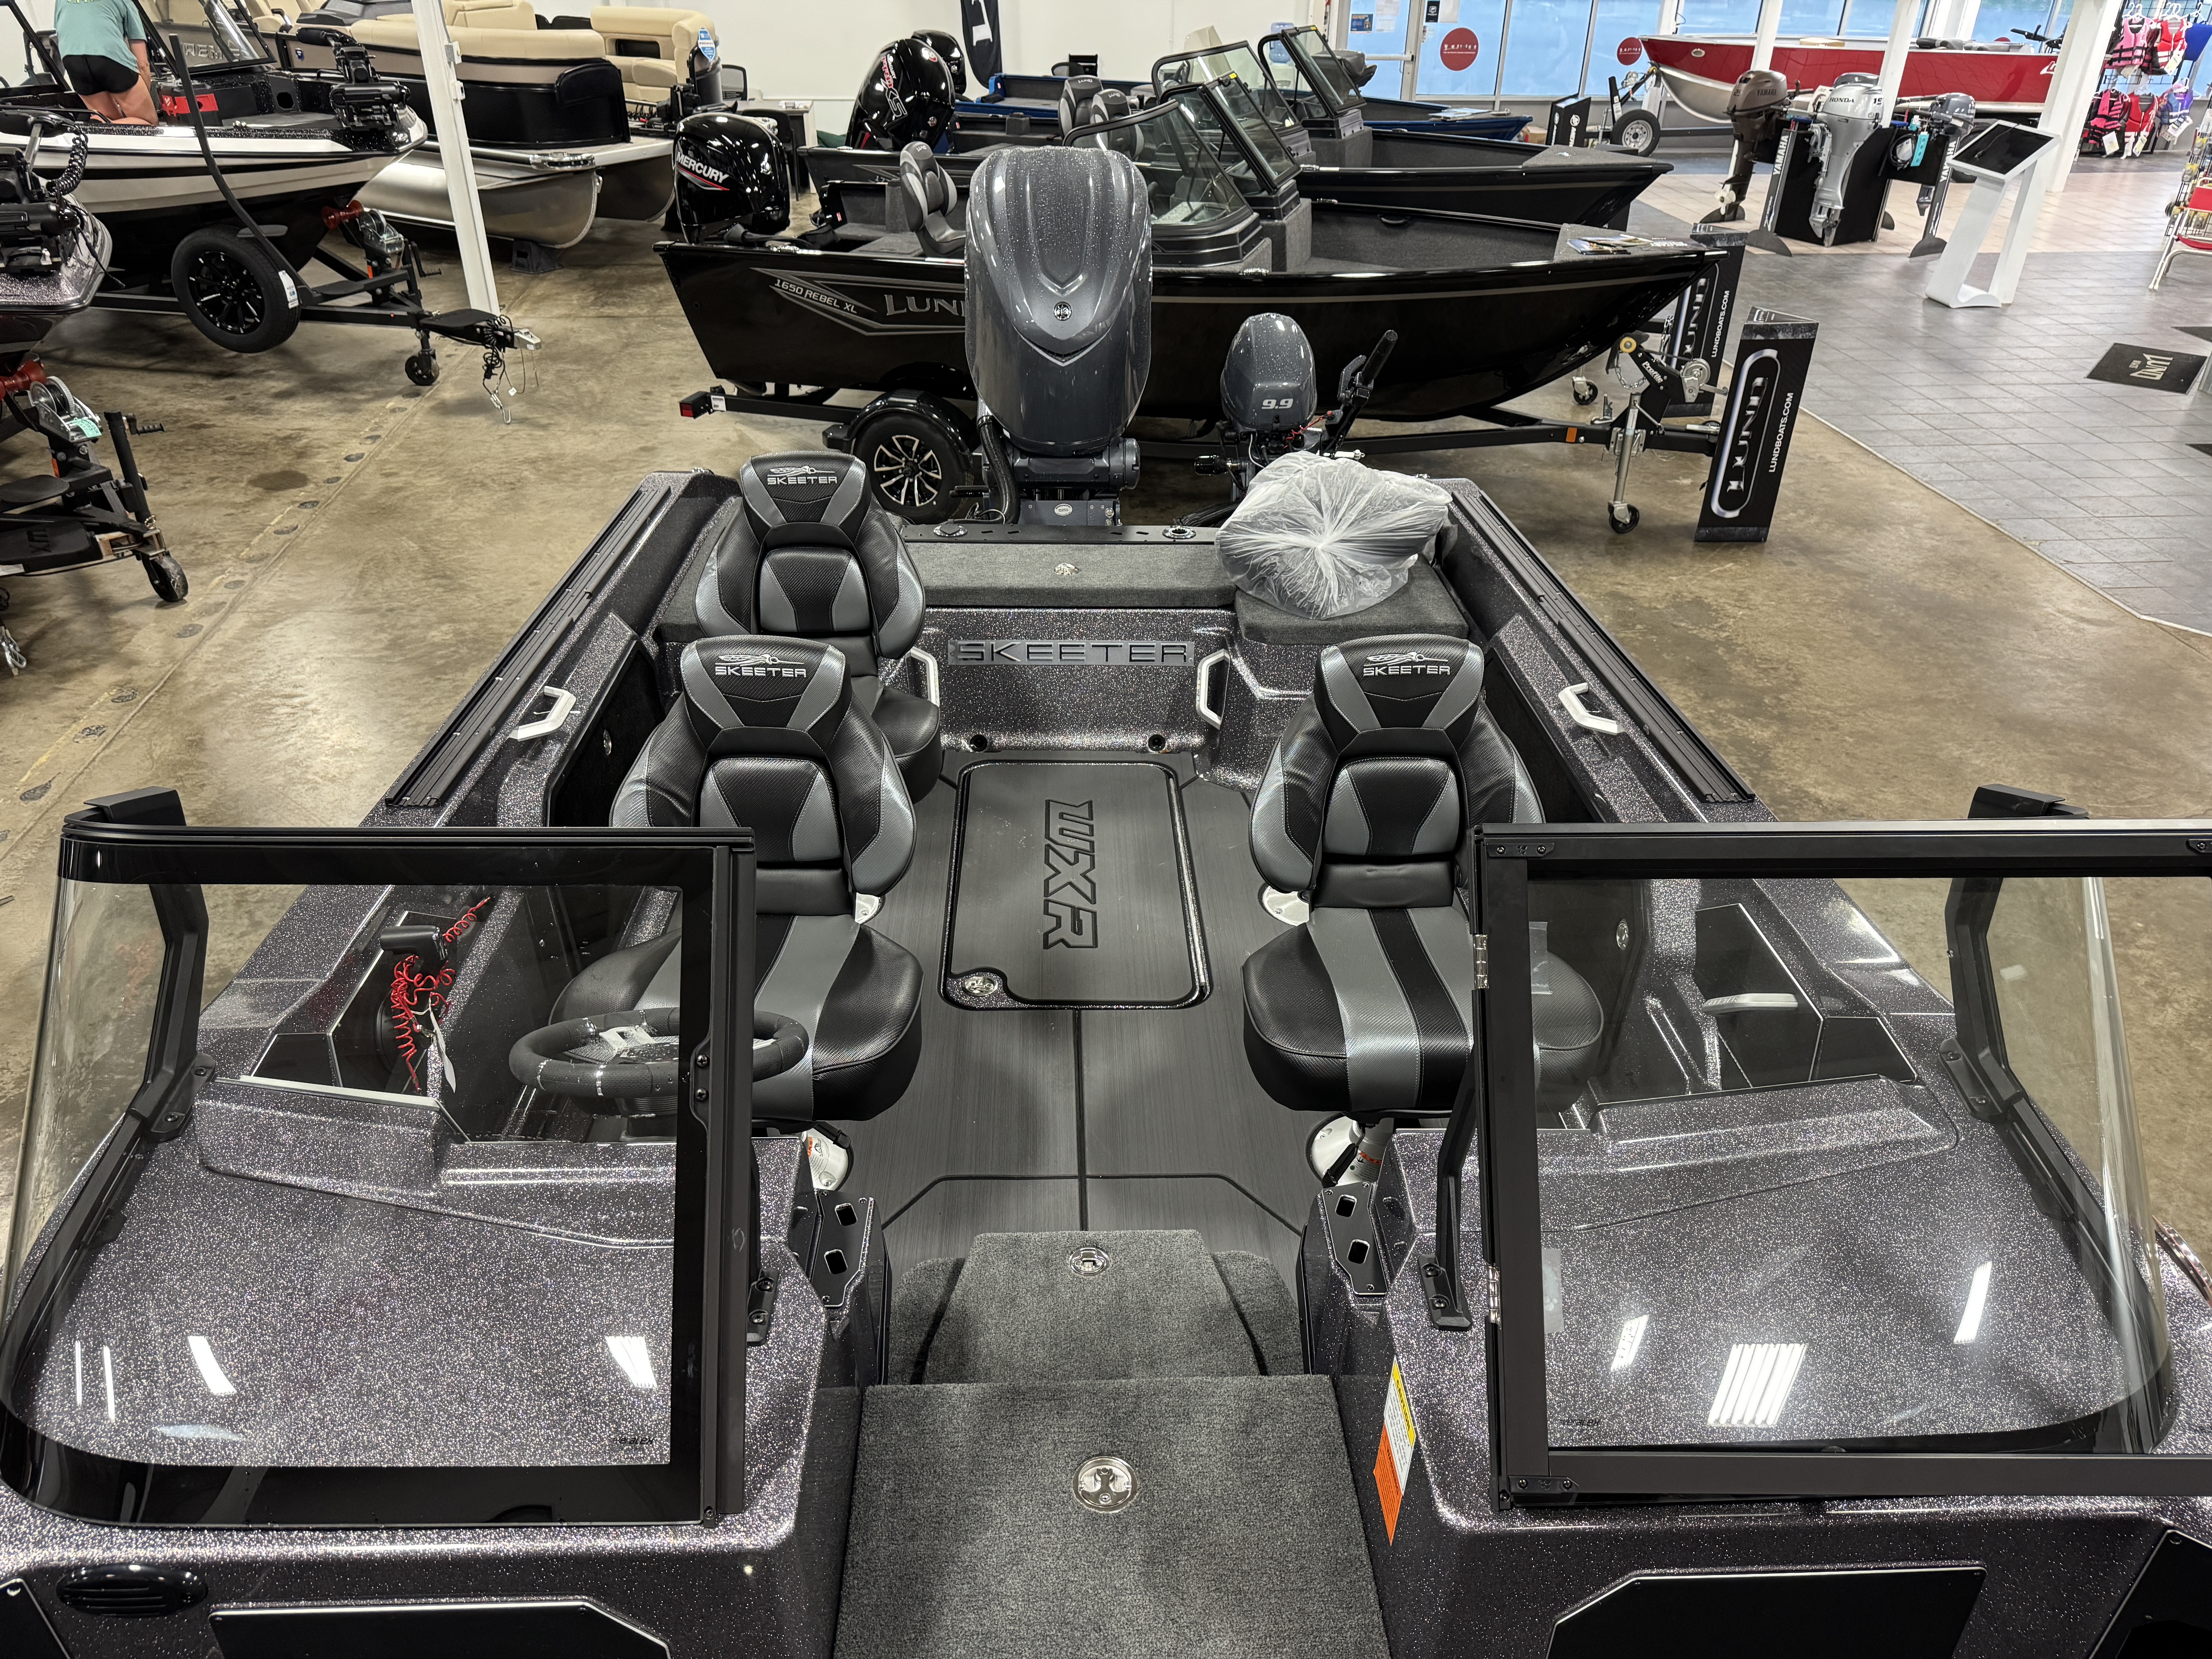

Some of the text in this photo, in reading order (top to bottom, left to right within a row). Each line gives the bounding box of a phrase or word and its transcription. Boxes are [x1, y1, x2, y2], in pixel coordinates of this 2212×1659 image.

[677, 151, 730, 184] MERCURY
[1772, 135, 1789, 175] YAMAHA
[775, 279, 857, 314] 1650 REBEL XL
[884, 294, 965, 317] LUN
[1683, 278, 1710, 361] UND
[1711, 290, 1730, 358] LUNDBOATS.COM
[1641, 361, 1663, 383] Profile
[1261, 398, 1293, 410] 9.9
[1727, 377, 1768, 493] LUND
[1769, 392, 1794, 473] LUNDBOATS.COM
[767, 476, 838, 485] SKEETER
[957, 641, 1188, 663] SKEETER
[714, 665, 807, 678] SKEETER
[1363, 665, 1450, 677] SKEETER
[1042, 798, 1098, 950] WXR
[1396, 1379, 1410, 1432] CAUTION
